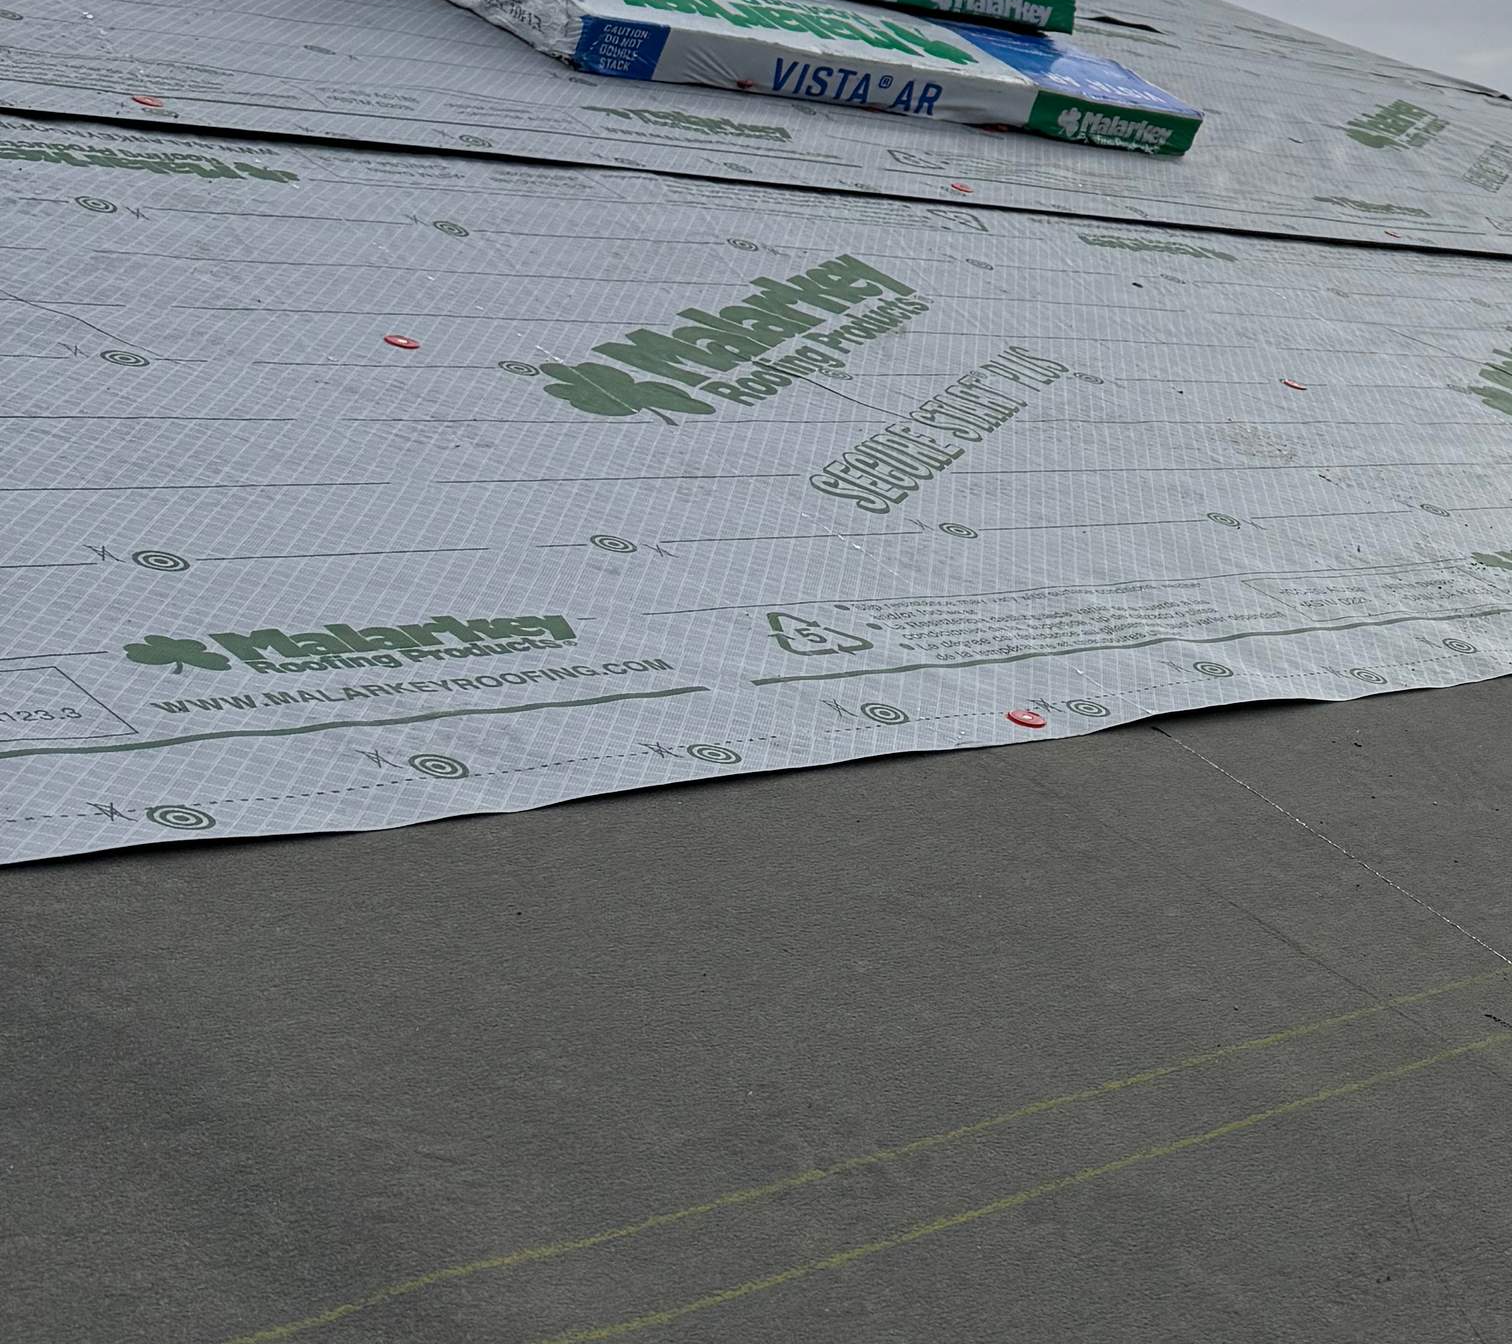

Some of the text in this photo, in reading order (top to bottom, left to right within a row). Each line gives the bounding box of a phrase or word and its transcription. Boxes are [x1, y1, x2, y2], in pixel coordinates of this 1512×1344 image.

[605, 34, 643, 49] DO NOT
[600, 57, 631, 72] STACK
[891, 80, 943, 116] AR
[1081, 111, 1173, 146] Malarkey
[591, 253, 917, 387] Malarkey
[699, 340, 832, 406] Roofing
[809, 423, 965, 514] SECURE
[996, 344, 1071, 393] PLUS
[210, 614, 578, 663] Malarkey
[245, 651, 401, 676] Roofing
[149, 658, 675, 716] WWW.MALARKEYROOFING.COM
